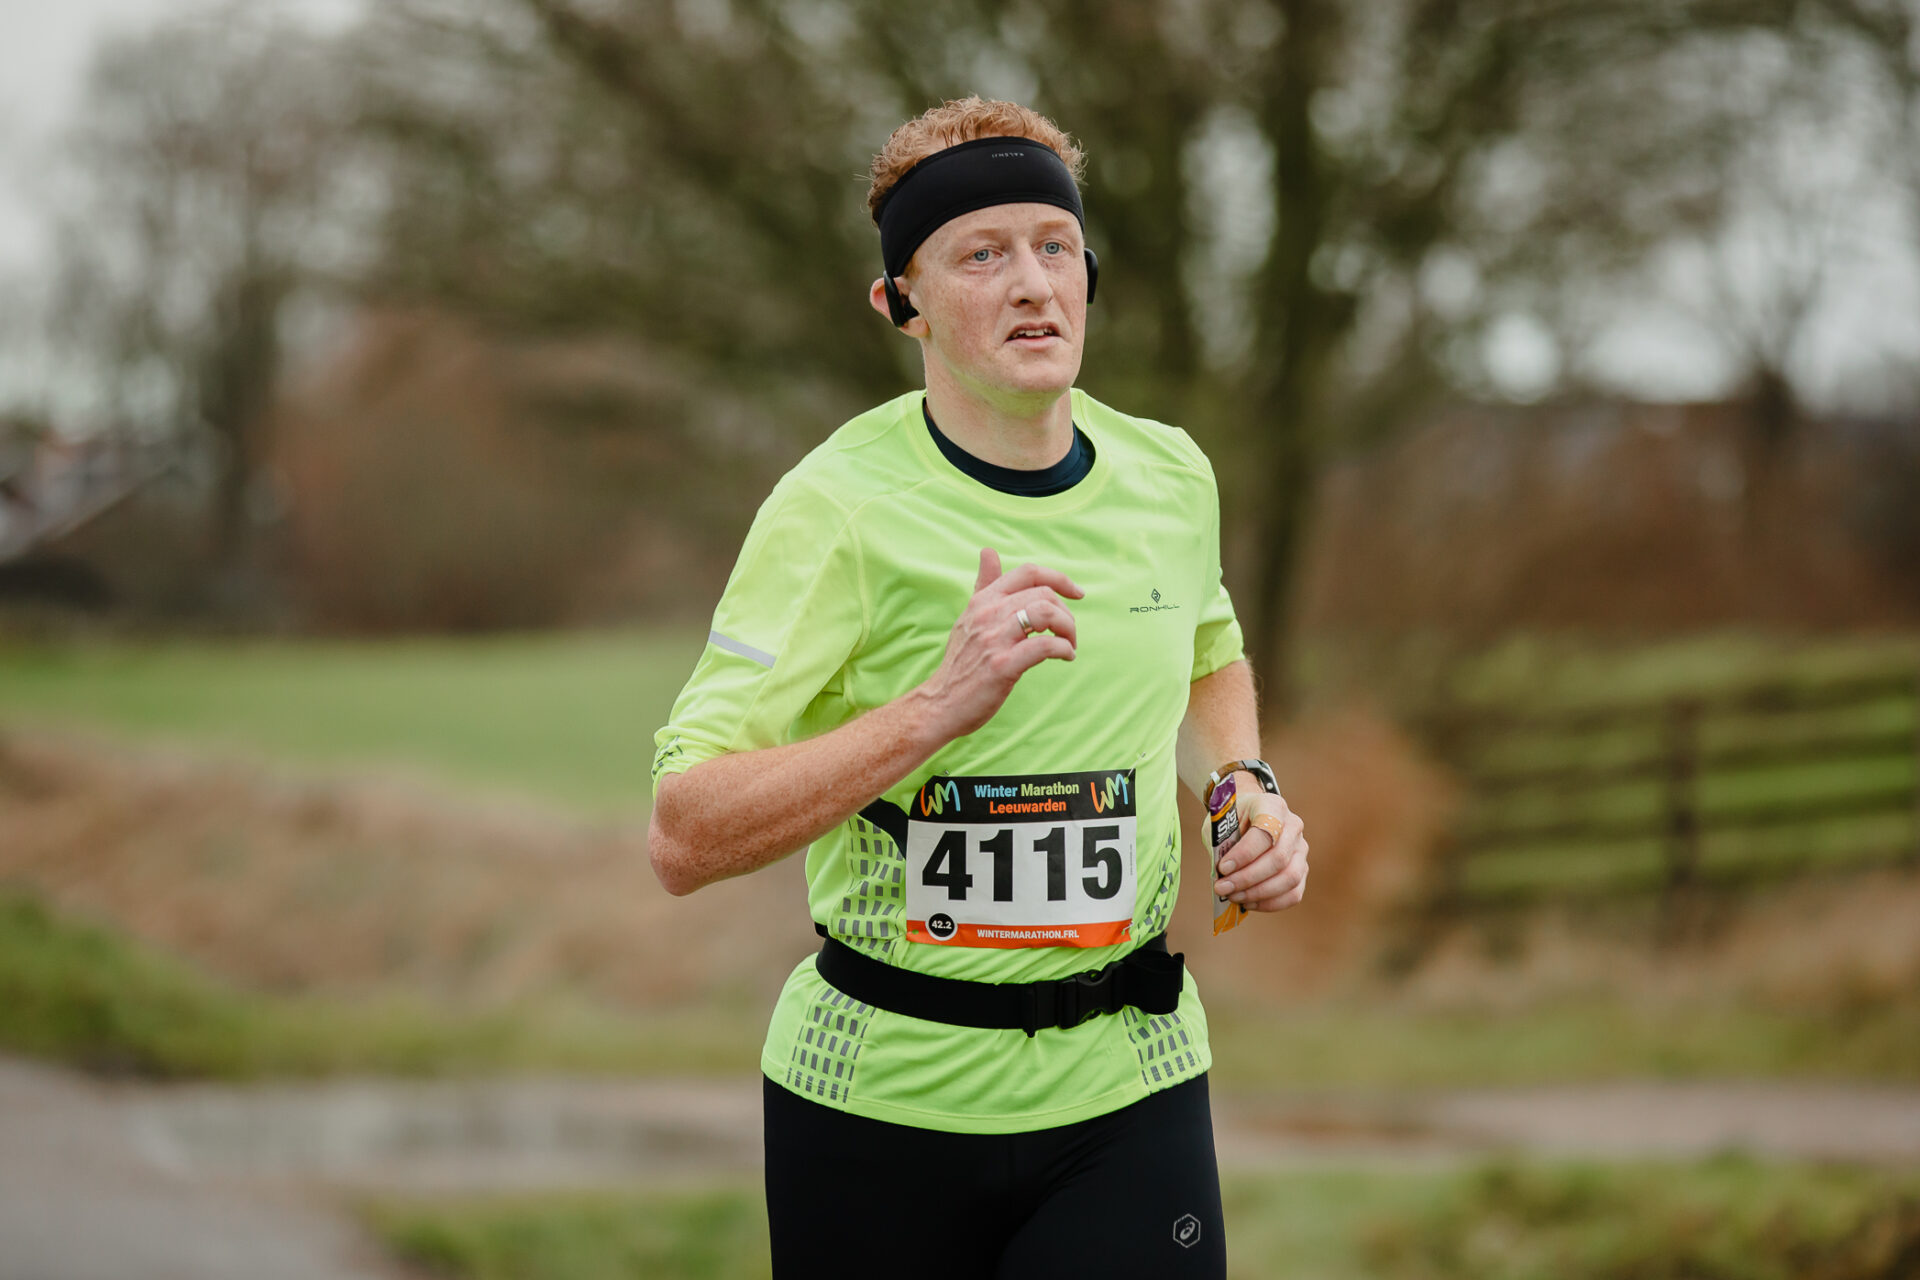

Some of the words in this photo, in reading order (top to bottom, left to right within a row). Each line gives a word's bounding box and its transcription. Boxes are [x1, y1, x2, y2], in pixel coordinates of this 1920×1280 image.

[974, 784, 1018, 798] Winter
[1020, 781, 1080, 797] Marathon
[989, 799, 1067, 814] Leeuwarden
[922, 825, 1123, 902] 4115
[931, 920, 952, 930] 42.2
[977, 929, 1080, 940] WINTERMARATHON.FRL
